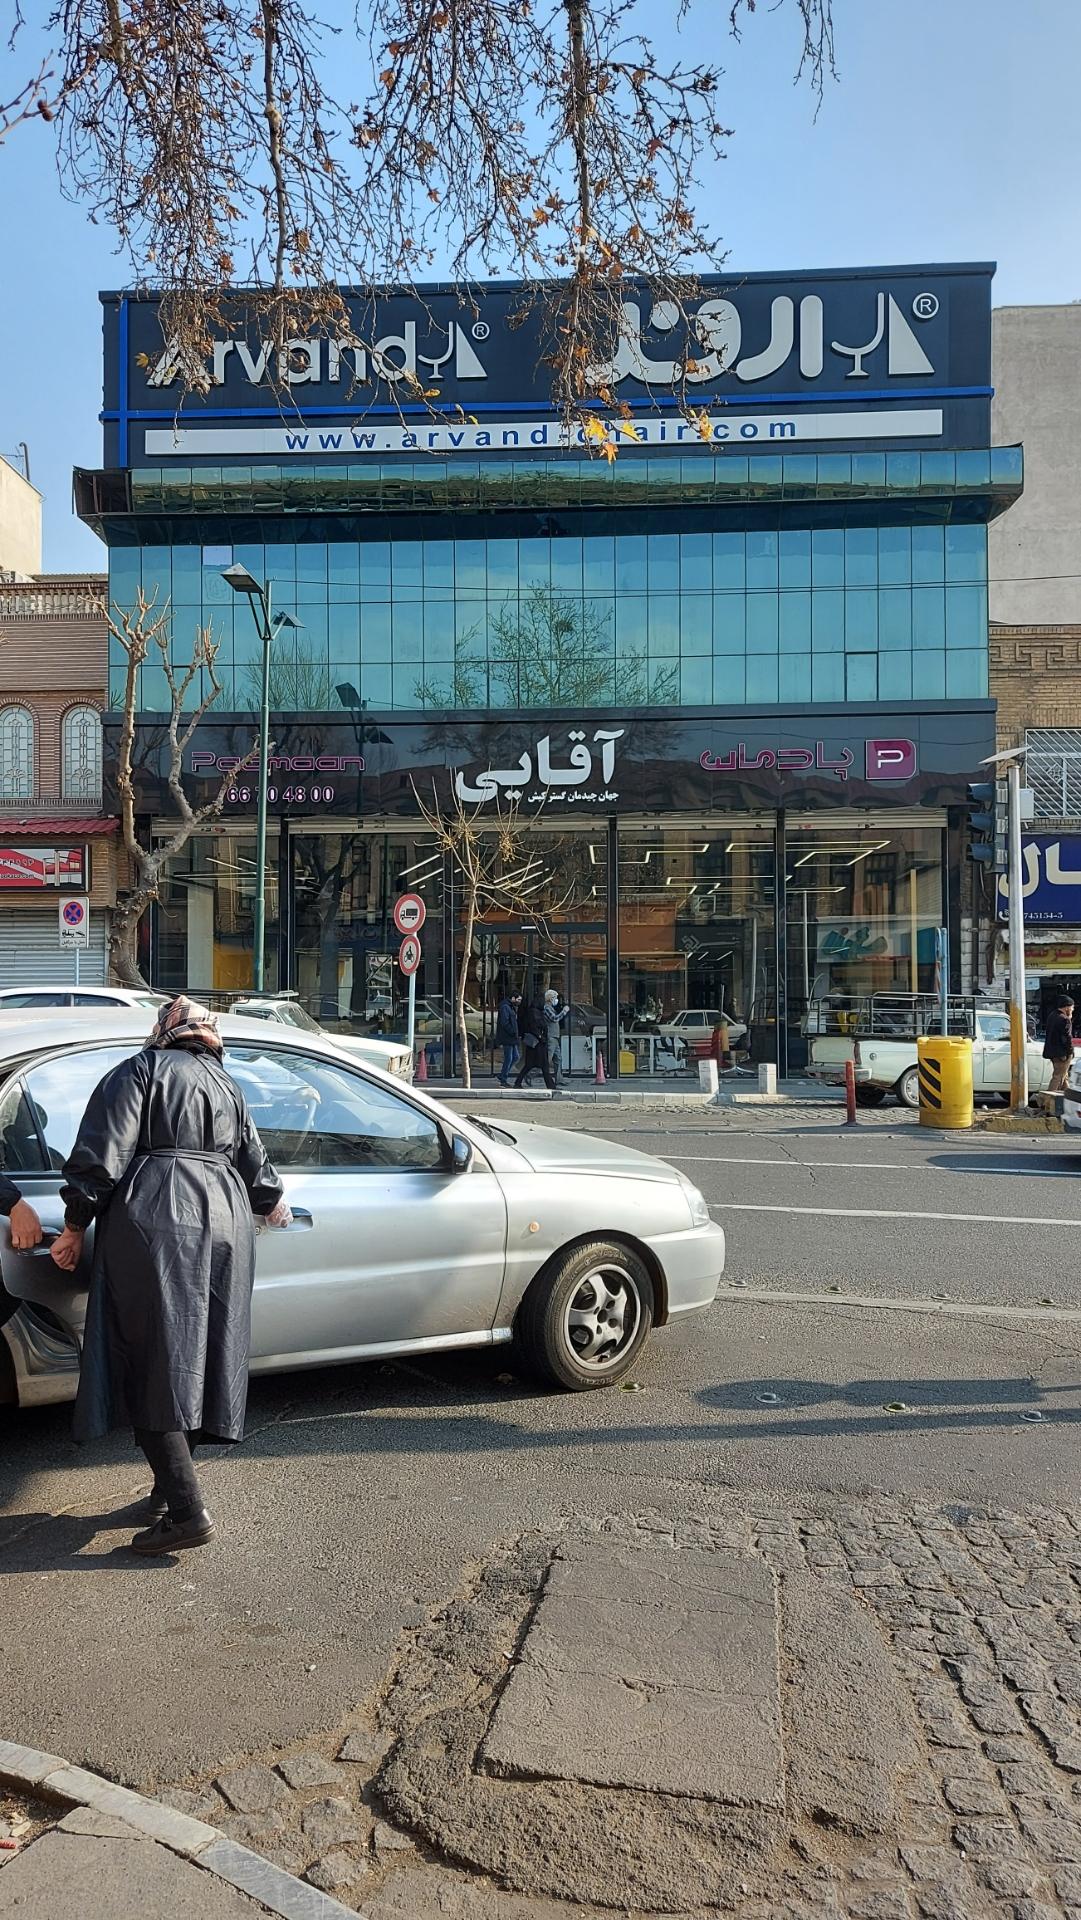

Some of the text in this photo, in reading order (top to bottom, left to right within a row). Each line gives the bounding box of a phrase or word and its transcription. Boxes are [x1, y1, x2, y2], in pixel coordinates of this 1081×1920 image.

[146, 320, 417, 386] Arvand
[586, 294, 824, 384] اروند
[455, 729, 625, 803] آقایی
